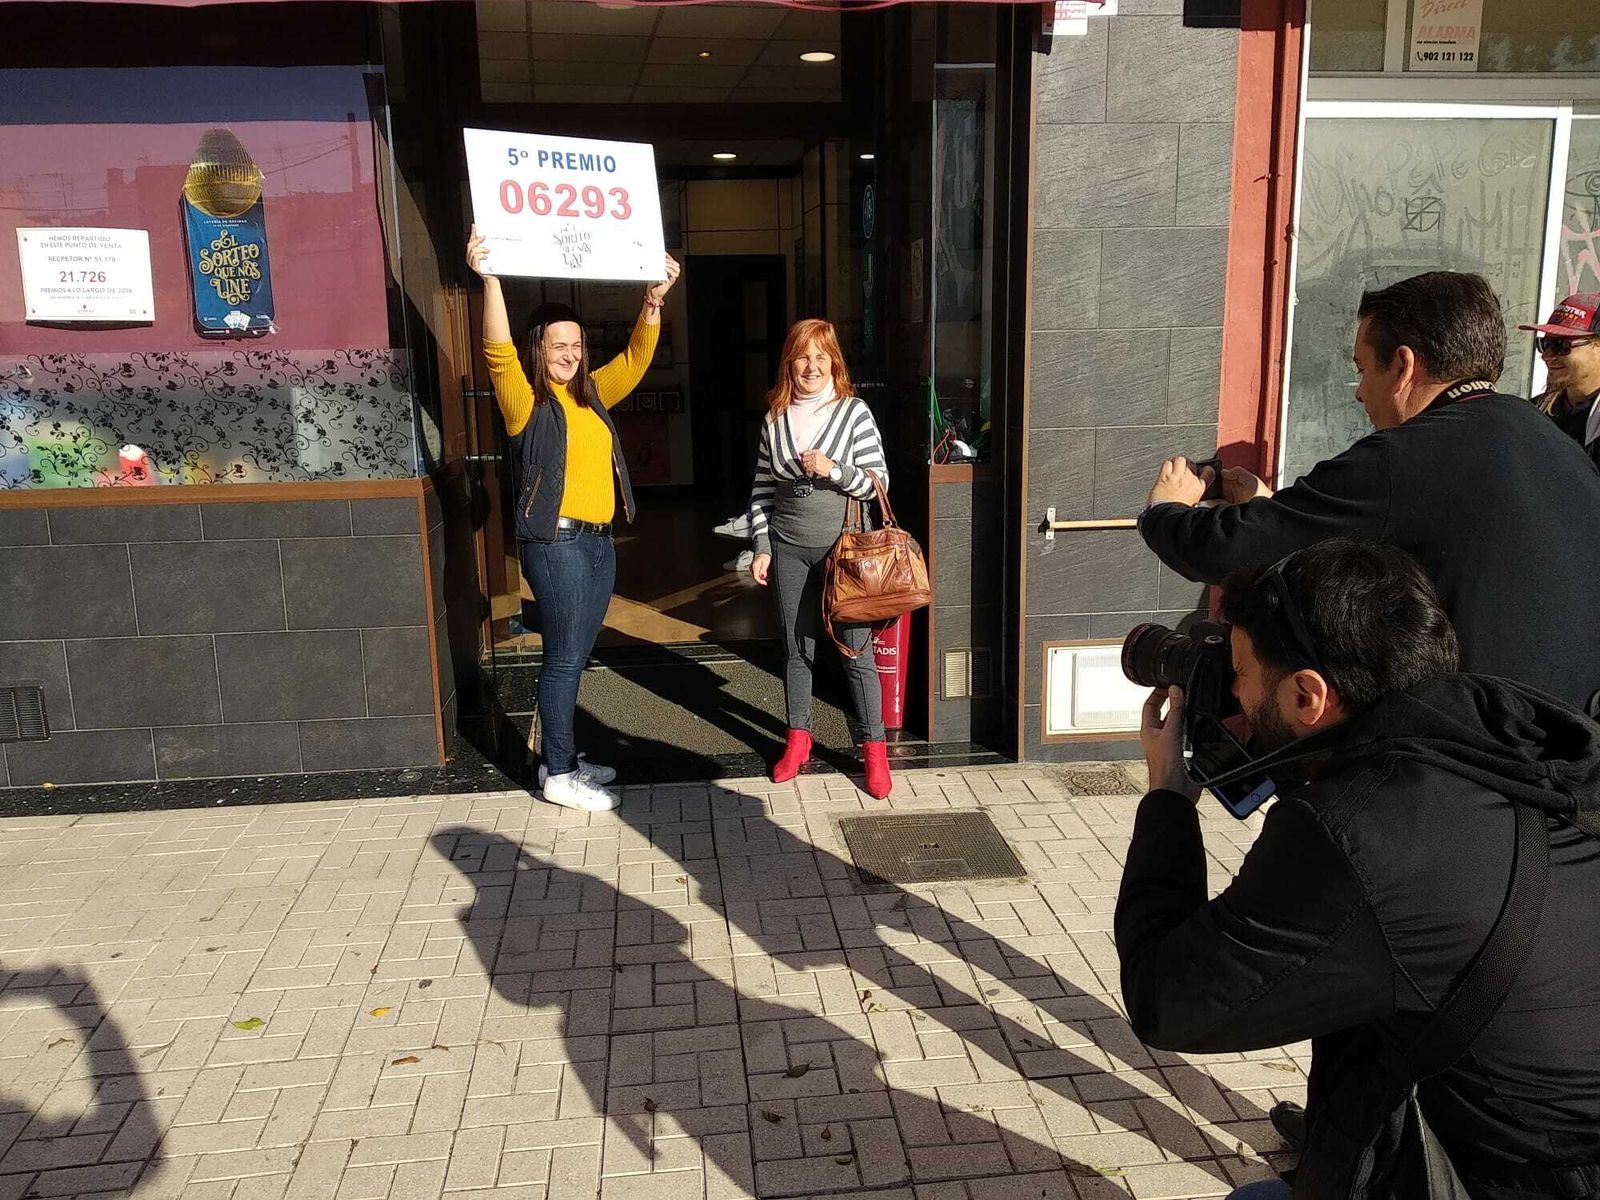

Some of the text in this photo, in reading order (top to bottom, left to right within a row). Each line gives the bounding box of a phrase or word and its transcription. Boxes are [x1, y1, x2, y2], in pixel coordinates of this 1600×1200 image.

[1423, 52, 1474, 61] 902 121 122
[537, 150, 616, 173] PREMIO
[500, 179, 632, 220] 06293
[199, 243, 260, 275] SORTEO
[214, 260, 261, 280] QUE NOS
[59, 271, 107, 283] 21.726
[210, 278, 251, 306] UNE
